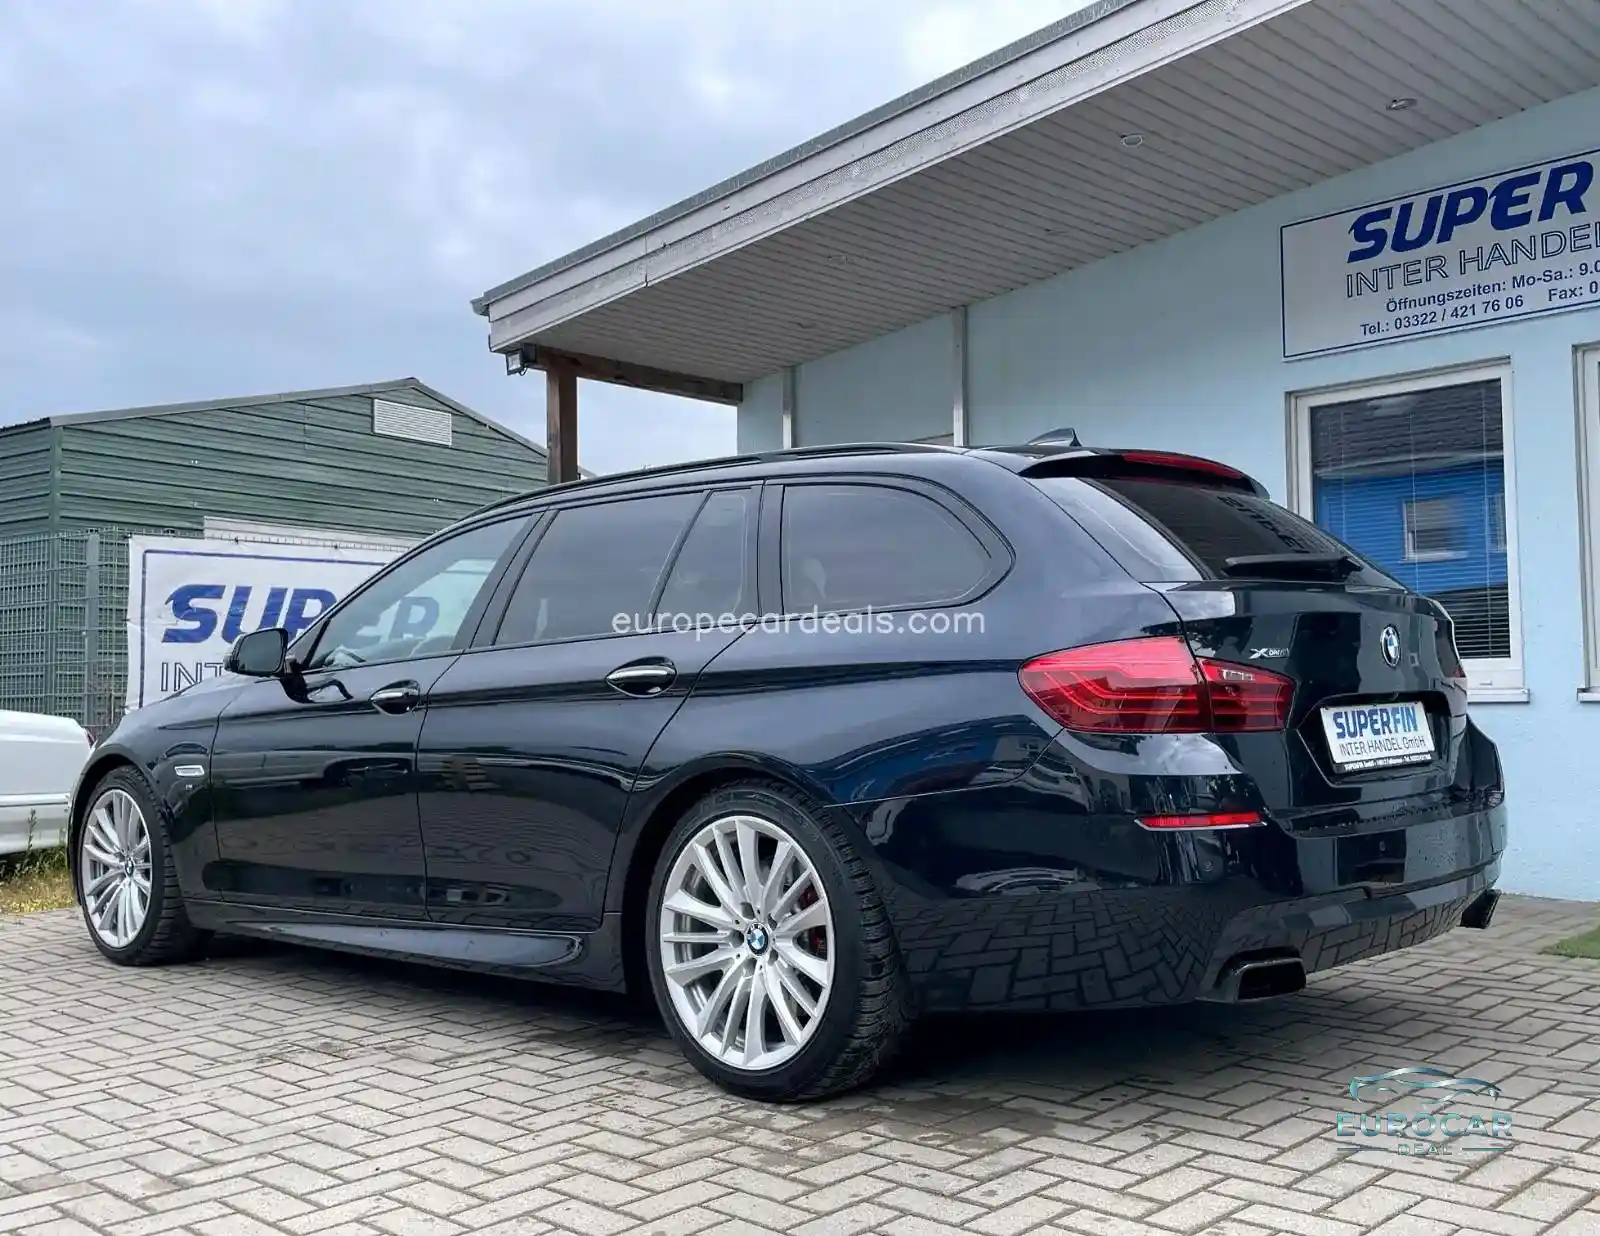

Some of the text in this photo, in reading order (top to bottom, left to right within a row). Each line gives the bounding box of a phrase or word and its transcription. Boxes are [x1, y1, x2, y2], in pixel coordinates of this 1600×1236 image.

[1347, 161, 1594, 263] SUPER
[1346, 255, 1449, 297] INTER
[1386, 281, 1506, 312] Öffnungszeiten:
[1512, 269, 1573, 289] Mo-Sa.:
[1360, 321, 1390, 336] Tel.:
[1394, 311, 1437, 330] 03322
[1450, 303, 1476, 319] 421
[1482, 299, 1500, 314] 76
[1505, 294, 1524, 310] 06
[1548, 286, 1583, 302] Fax:
[161, 662, 224, 692] INT
[1333, 706, 1418, 739] SUPERFIN
[1339, 736, 1426, 757] INTER HANDEL GmbH
